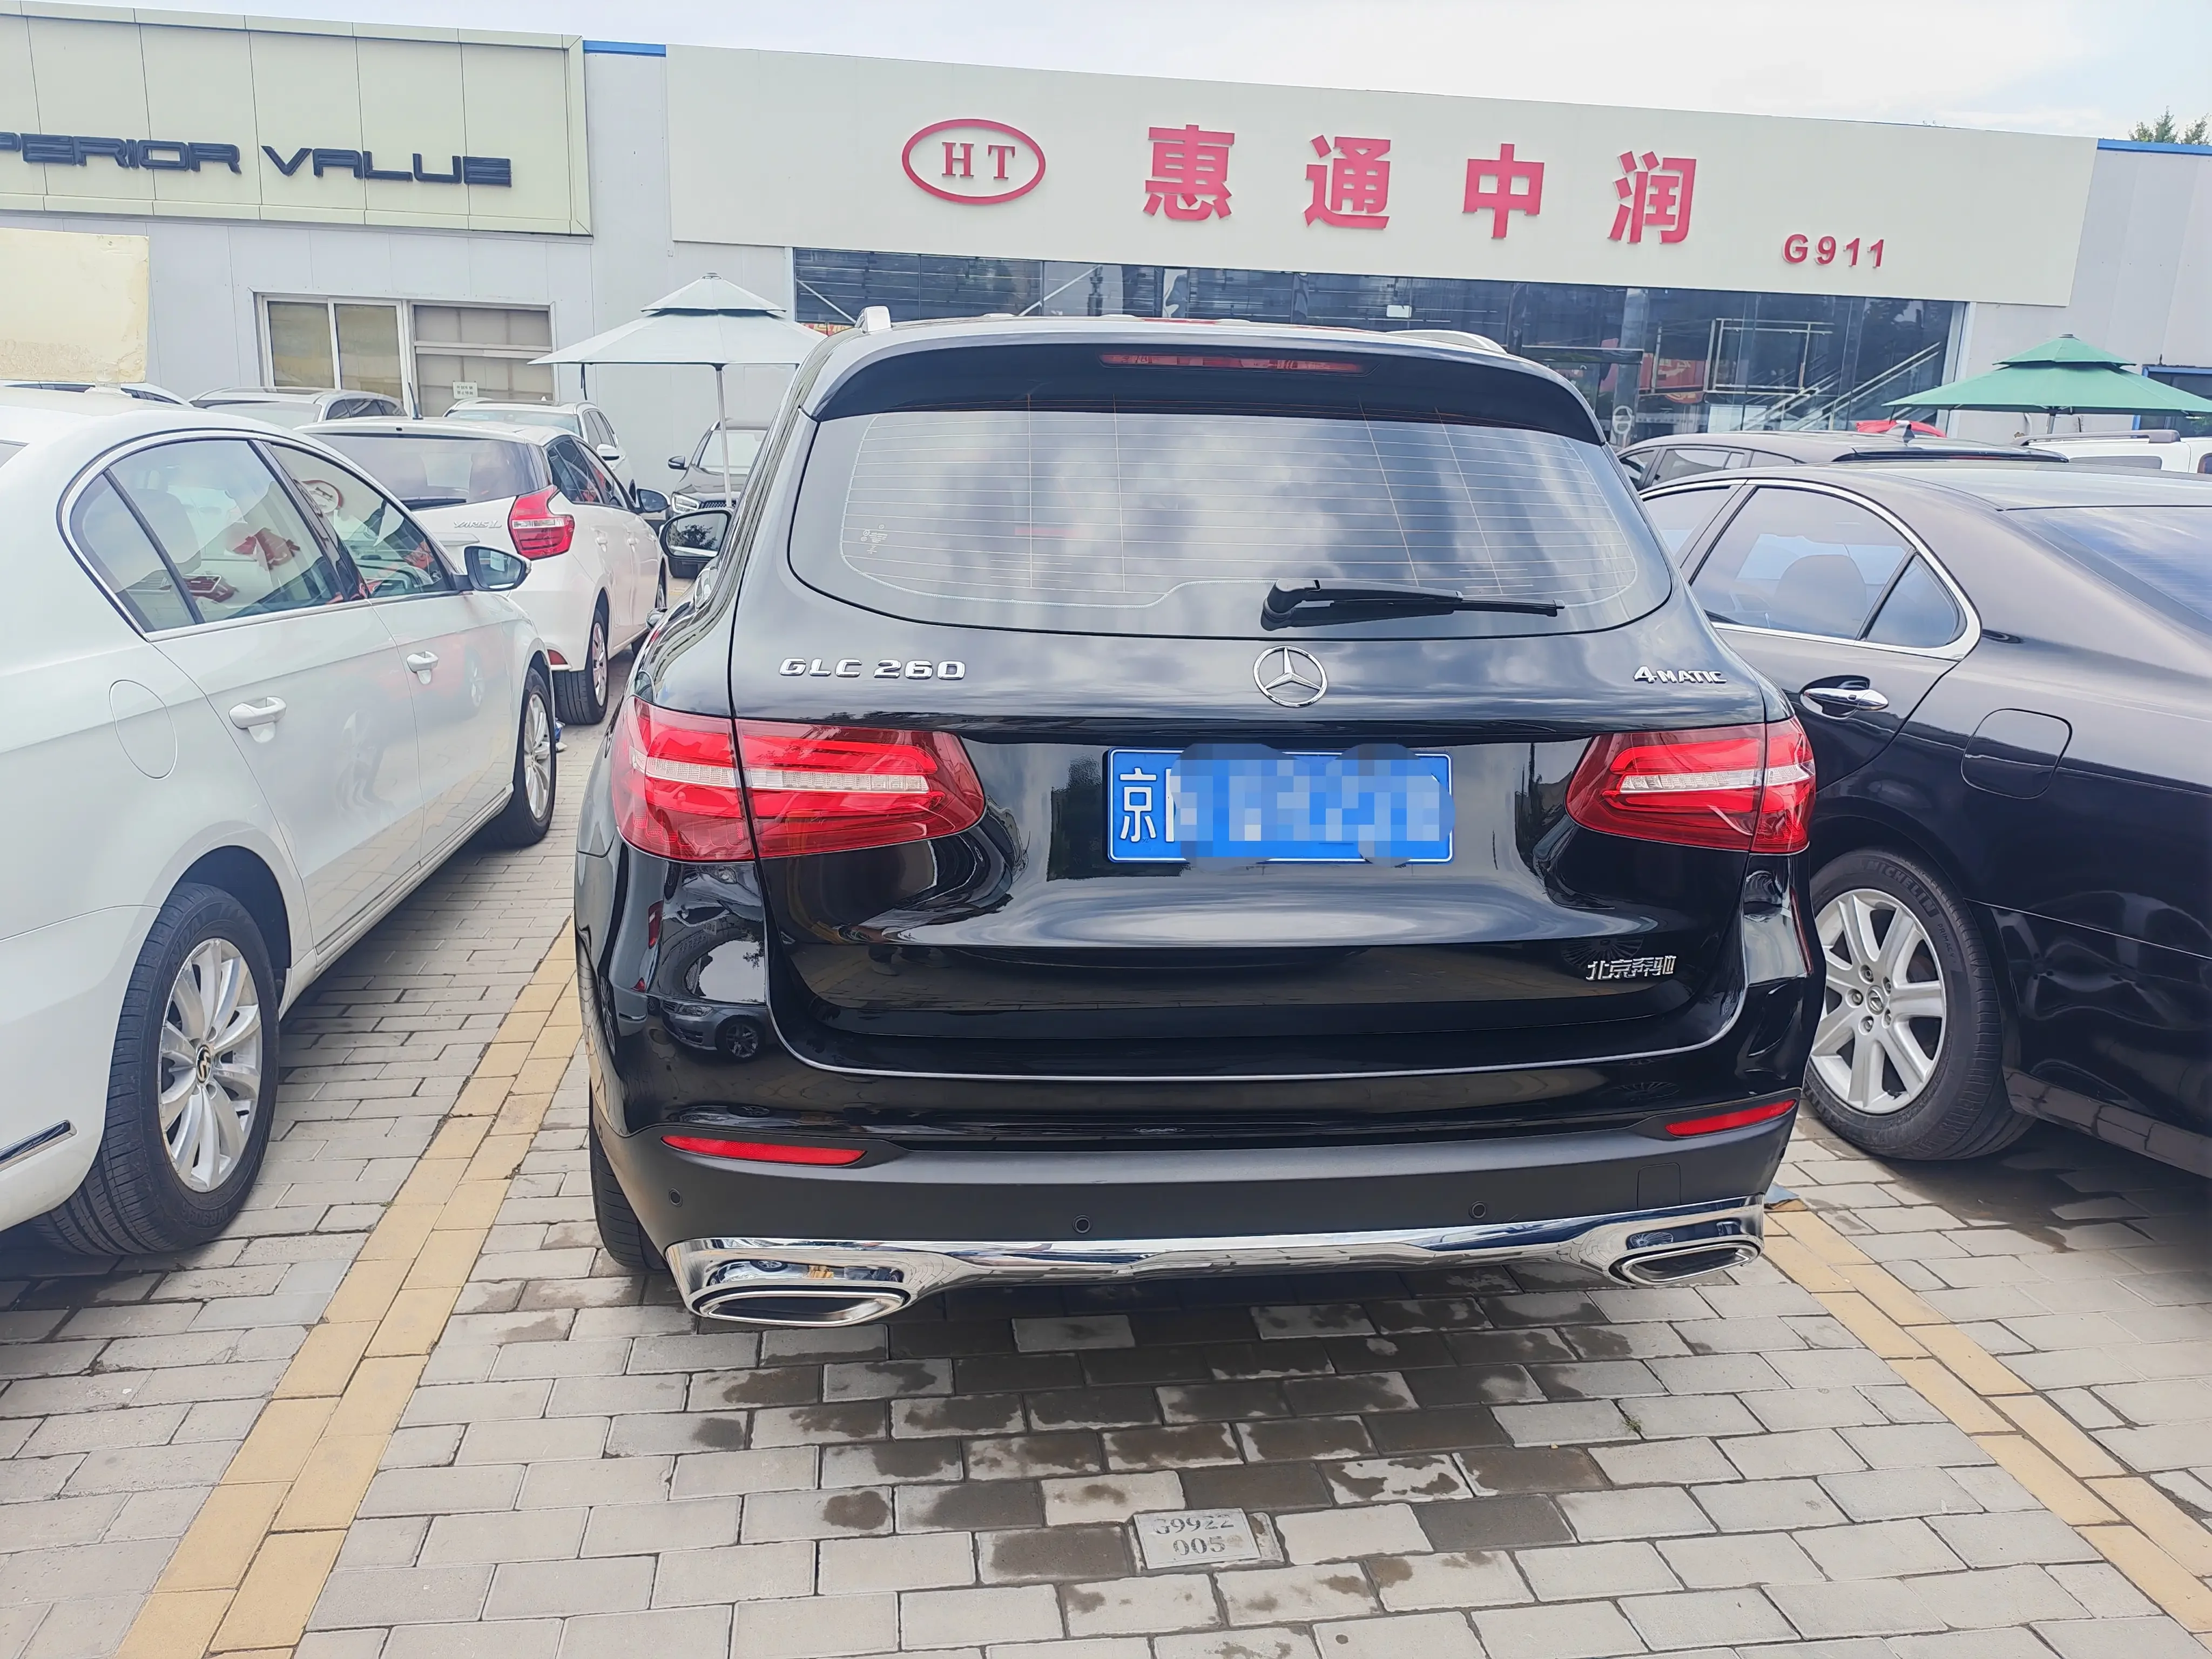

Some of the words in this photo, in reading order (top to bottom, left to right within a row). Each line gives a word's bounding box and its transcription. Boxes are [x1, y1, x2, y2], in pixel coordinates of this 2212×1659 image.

[261, 145, 512, 187] VALUE
[1143, 125, 1696, 244] 惠通中润
[1782, 233, 1885, 269] G911
[779, 658, 862, 677] GLC
[873, 659, 966, 680] 260
[1634, 665, 1727, 684] 4MATIC
[1866, 860, 1937, 914] MICHELIN
[1937, 922, 1956, 959] PRIMACY
[1585, 955, 1677, 981] 北京奔驰
[1172, 1535, 1226, 1556] 005
